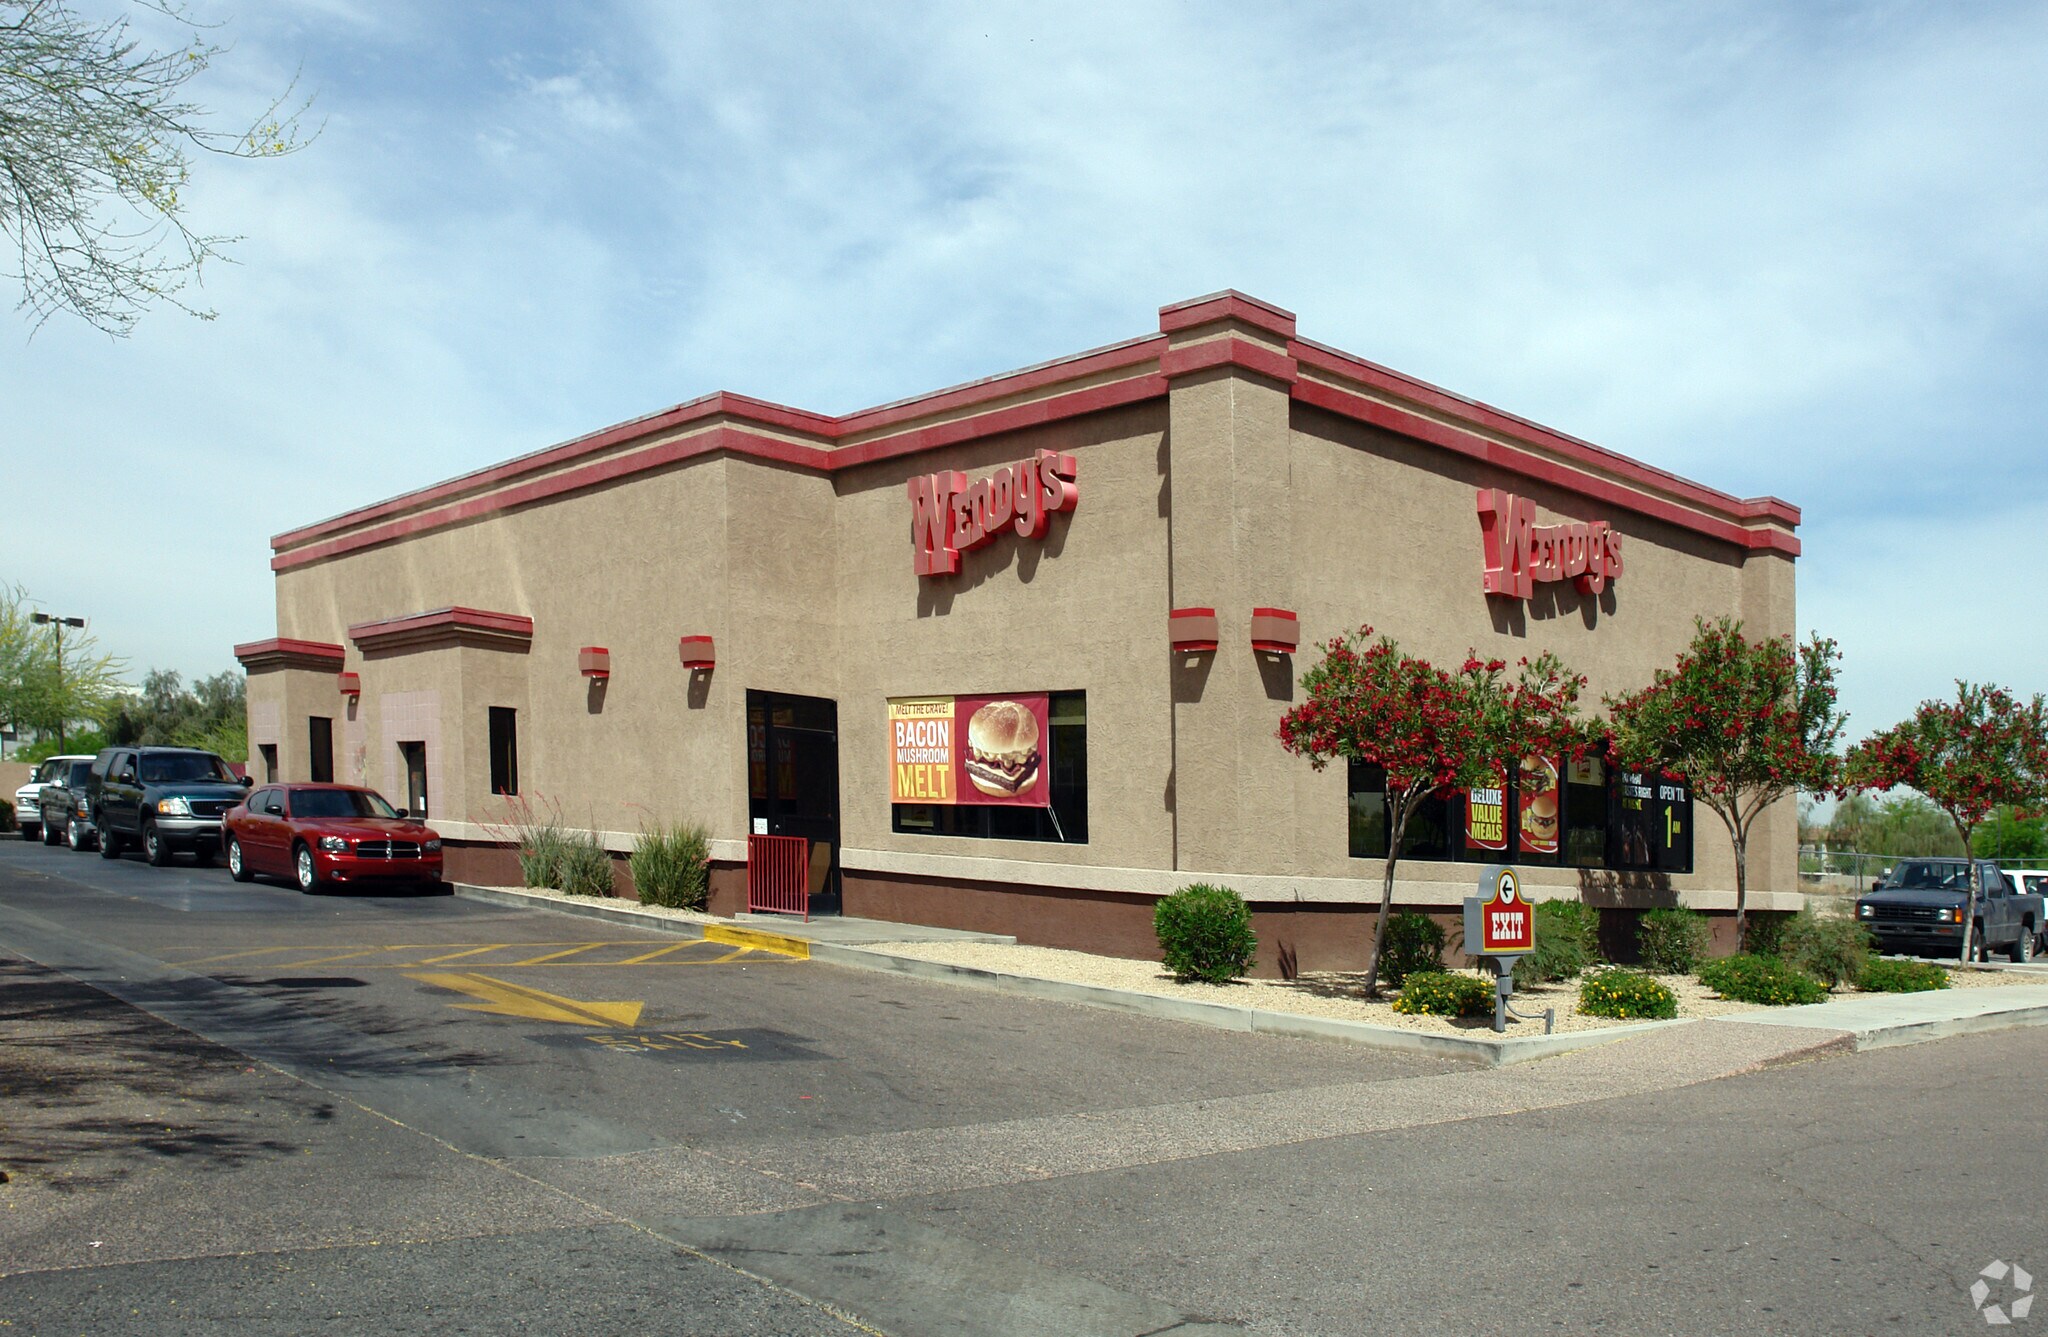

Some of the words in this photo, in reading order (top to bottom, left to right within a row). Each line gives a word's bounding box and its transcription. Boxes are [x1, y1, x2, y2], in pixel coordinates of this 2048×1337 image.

[913, 704, 924, 714] THE
[896, 720, 949, 748] BACON
[897, 748, 949, 764] MUSHROOM
[897, 764, 949, 799] MELT
[1471, 788, 1502, 805] DELUXE
[1659, 785, 1675, 800] OPEN
[1471, 804, 1502, 823] VALUE
[1471, 823, 1502, 841] MEALS
[1665, 806, 1672, 848] 1
[1673, 821, 1681, 833] AM
[1491, 912, 1524, 940] EXIT
